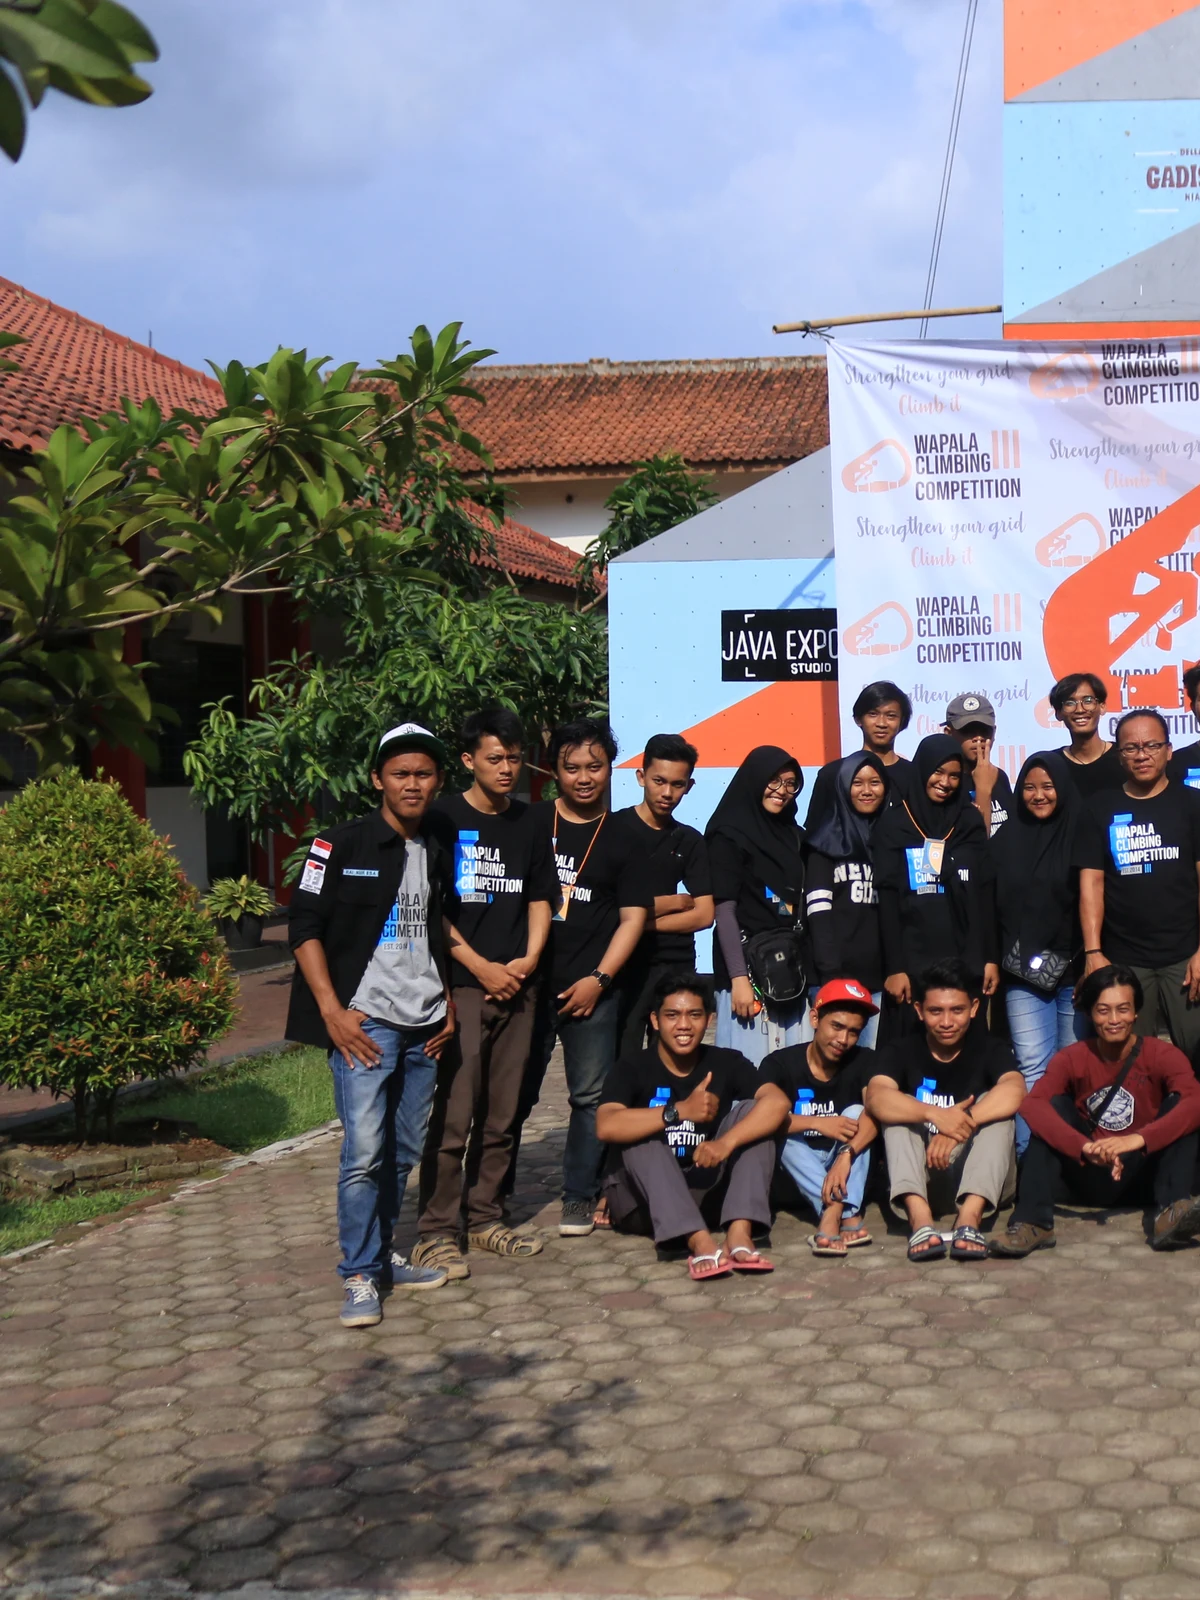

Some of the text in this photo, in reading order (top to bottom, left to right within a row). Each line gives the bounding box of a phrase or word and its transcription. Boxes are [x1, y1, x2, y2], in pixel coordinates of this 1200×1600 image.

[1102, 343, 1166, 360] WAPALA
[845, 360, 1013, 390] Strengthen your grid
[1102, 359, 1180, 380] CLIMBING
[914, 432, 978, 454] WAPALA
[1050, 437, 1138, 464] Strengthen
[1144, 444, 1180, 461] your
[916, 453, 990, 475] CLIMBING
[916, 478, 1021, 501] COMPETITION
[857, 511, 1026, 542] Strengthen your grid
[916, 596, 980, 616] WAPALA
[917, 616, 992, 638] CLIMBING
[722, 628, 838, 661] JAVA EXPO
[917, 642, 1022, 664] COMPETITION
[791, 662, 832, 674] STUDIO
[994, 679, 1031, 707] grid
[1116, 823, 1155, 839] WAPALA
[1116, 834, 1162, 852] CLIMBING
[461, 846, 500, 862] WAPALA
[1118, 846, 1180, 865] COMPETITION
[462, 860, 505, 877] CLIMBING
[461, 876, 523, 893] COMPETITION
[802, 1100, 834, 1116] WAPALA
